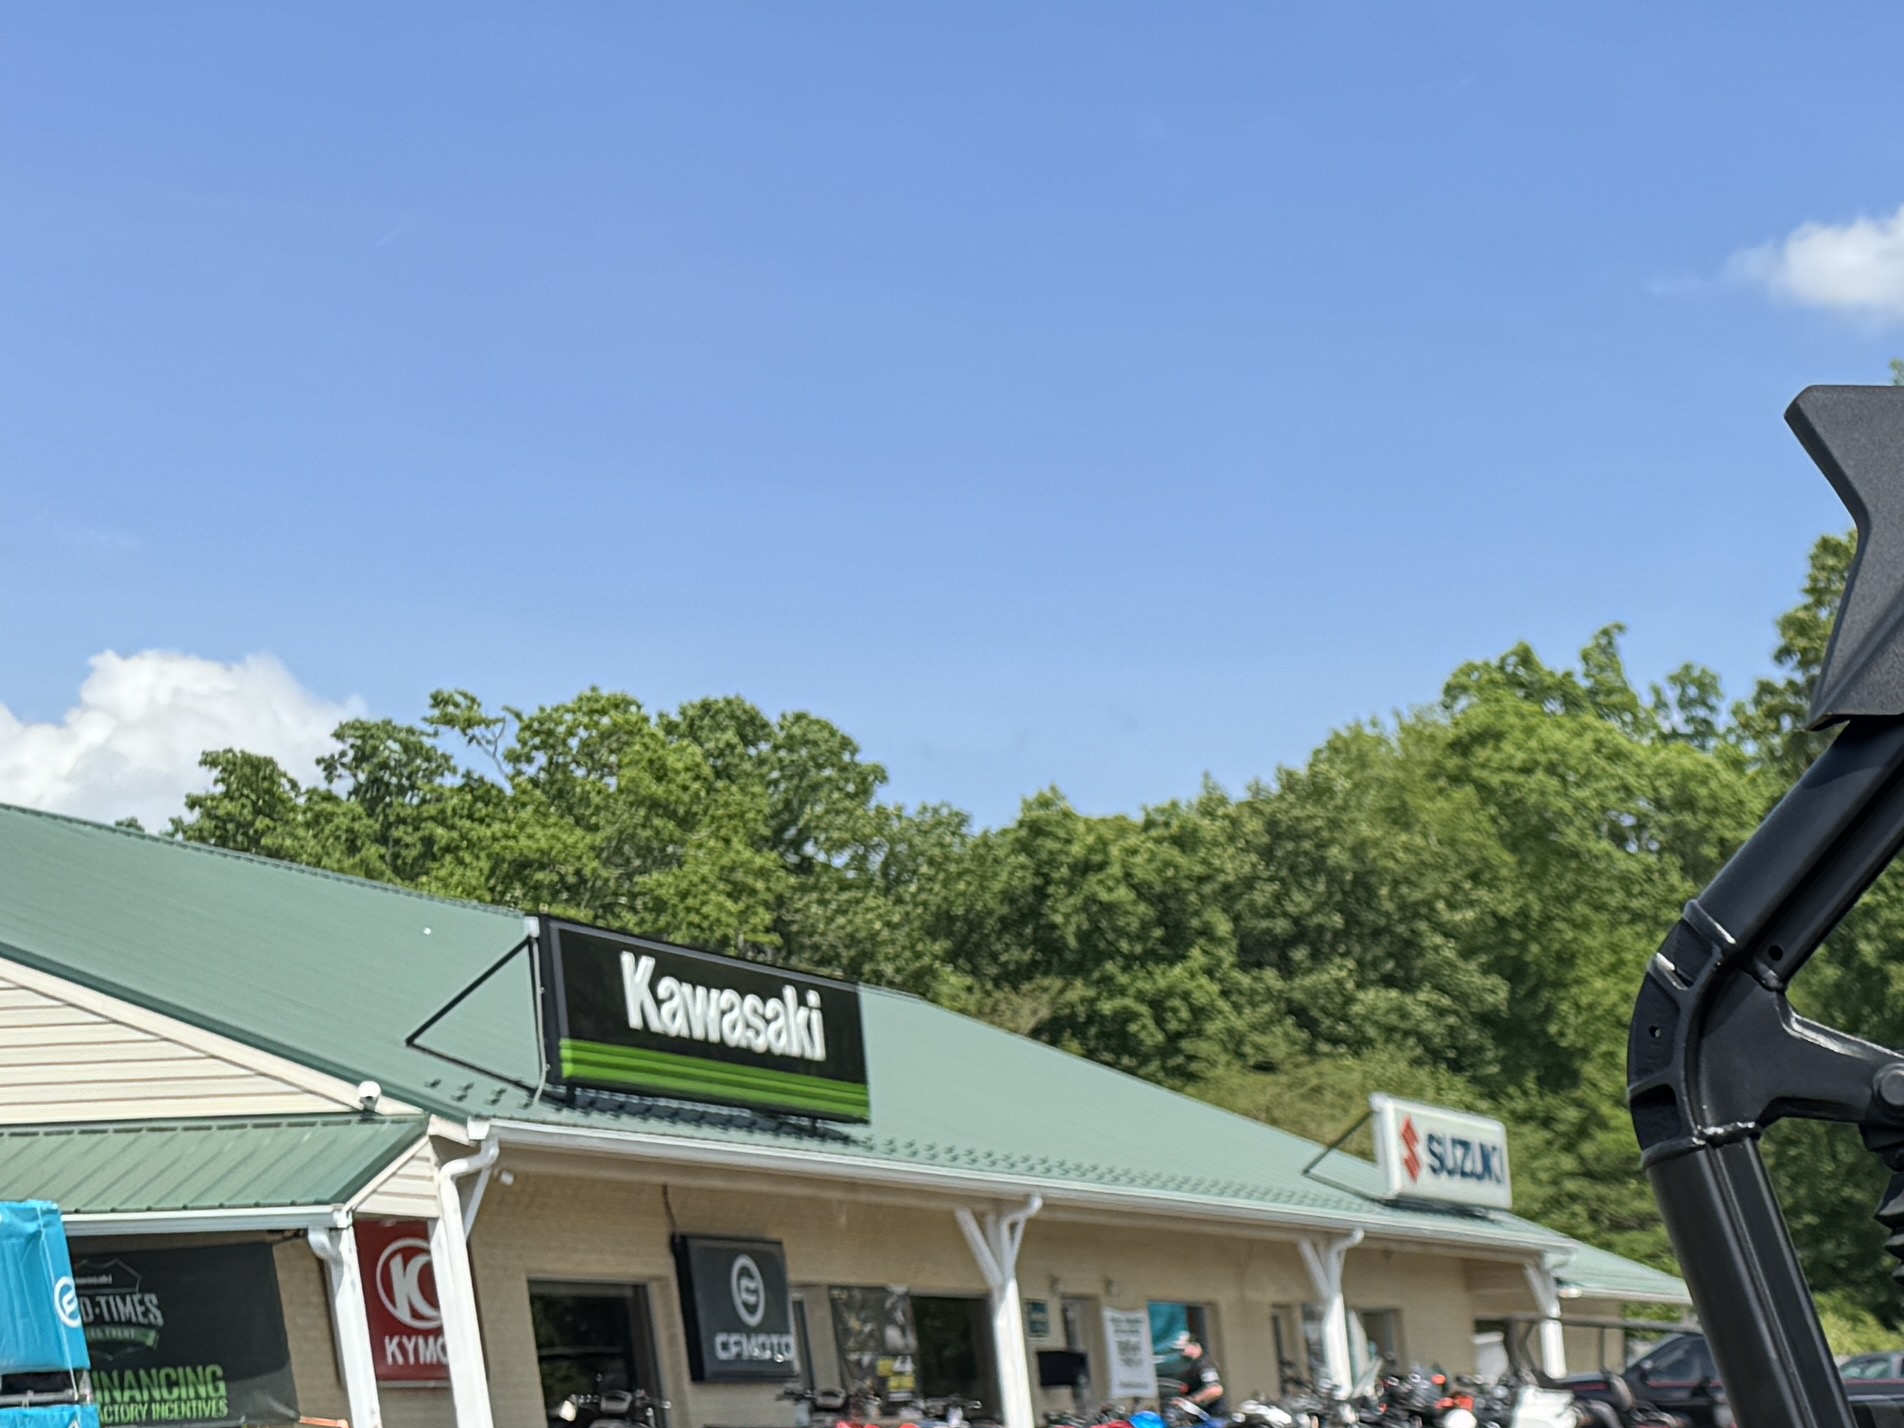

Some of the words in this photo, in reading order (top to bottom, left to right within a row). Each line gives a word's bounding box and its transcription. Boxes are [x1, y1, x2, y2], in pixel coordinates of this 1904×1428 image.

[620, 950, 826, 1061] Kawasaki
[1427, 1133, 1505, 1185] SUZUKI
[384, 1335, 449, 1365] KYMC
[714, 1331, 795, 1361] CFMOTO
[92, 1364, 227, 1404] INANCING
[100, 1402, 147, 1424] CTORY
[152, 1398, 229, 1420] INCENTIVES
